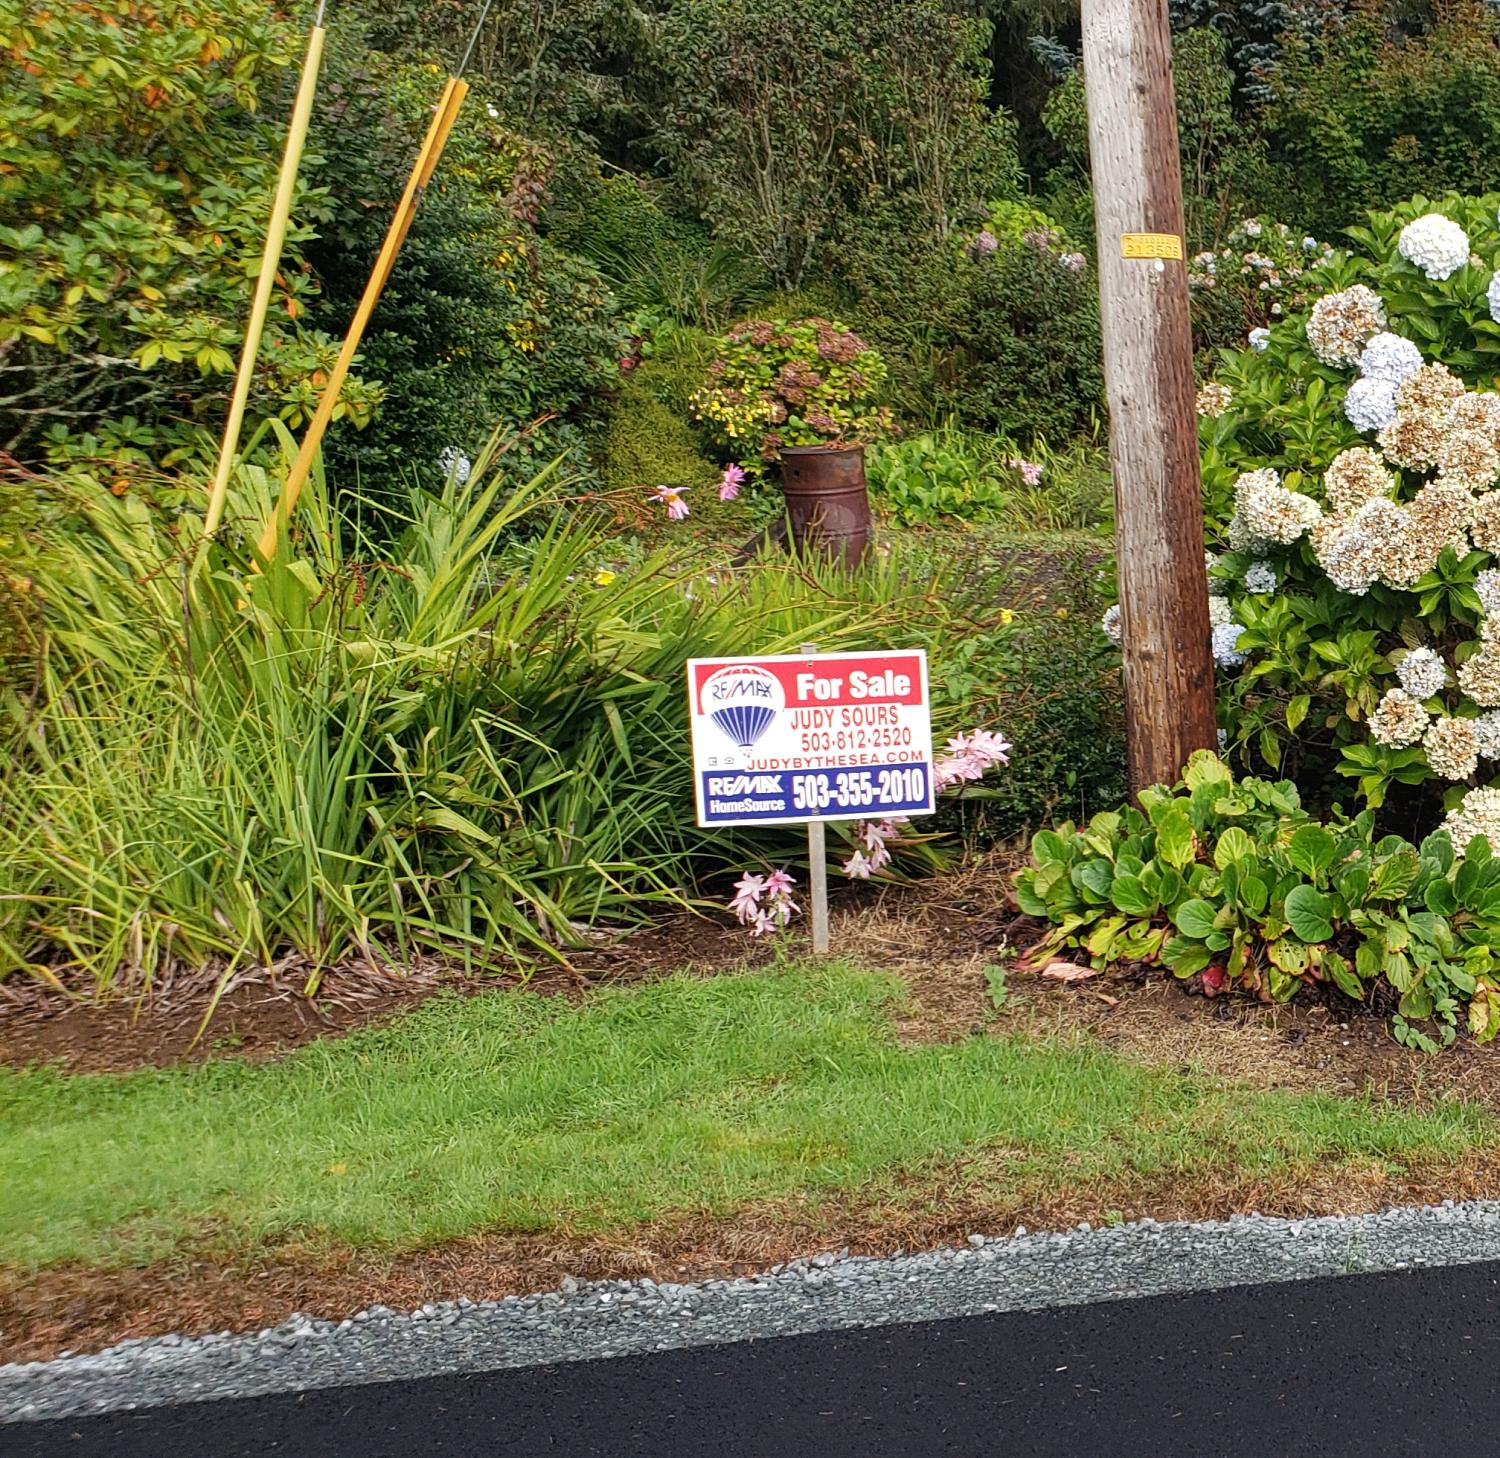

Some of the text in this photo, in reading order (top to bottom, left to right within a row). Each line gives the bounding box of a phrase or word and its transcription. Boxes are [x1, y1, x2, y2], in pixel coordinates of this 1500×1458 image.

[713, 680, 772, 699] RE/MAX
[797, 671, 910, 700] For Sale
[791, 706, 898, 729] JUDY SOURS
[748, 752, 923, 770] JUDYBYTHESEA.COM
[709, 775, 784, 796] RE/MAX
[793, 769, 924, 809] 503-355-2010
[710, 799, 785, 813] HomeSource
